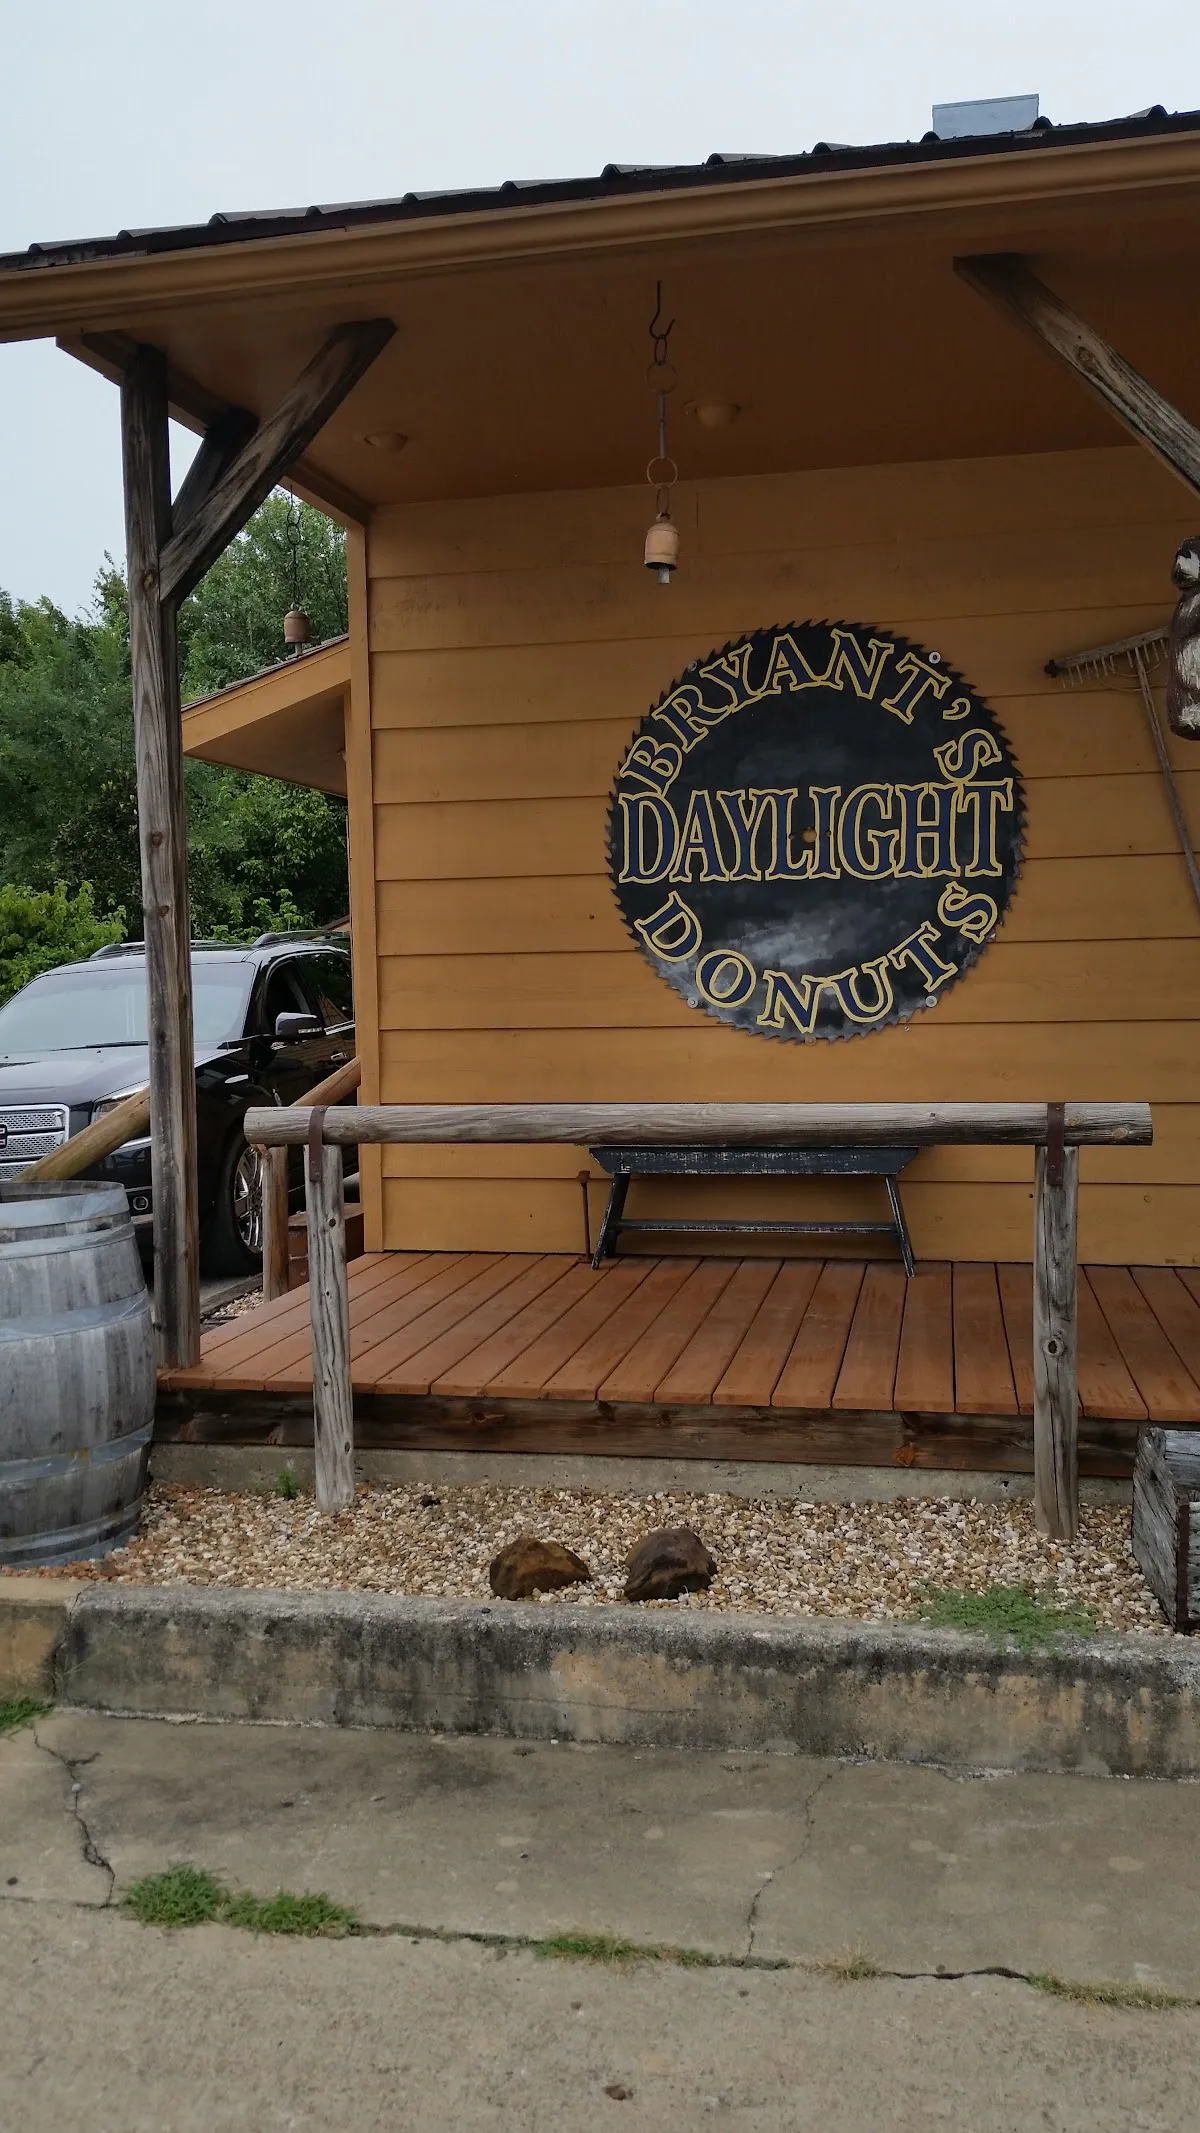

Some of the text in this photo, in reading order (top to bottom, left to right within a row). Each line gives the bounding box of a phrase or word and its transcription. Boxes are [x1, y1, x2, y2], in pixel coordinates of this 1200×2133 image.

[620, 629, 1002, 795] BRYANT'S
[619, 778, 1013, 882] DAYLIGHT
[635, 882, 998, 1034] DONUTS
